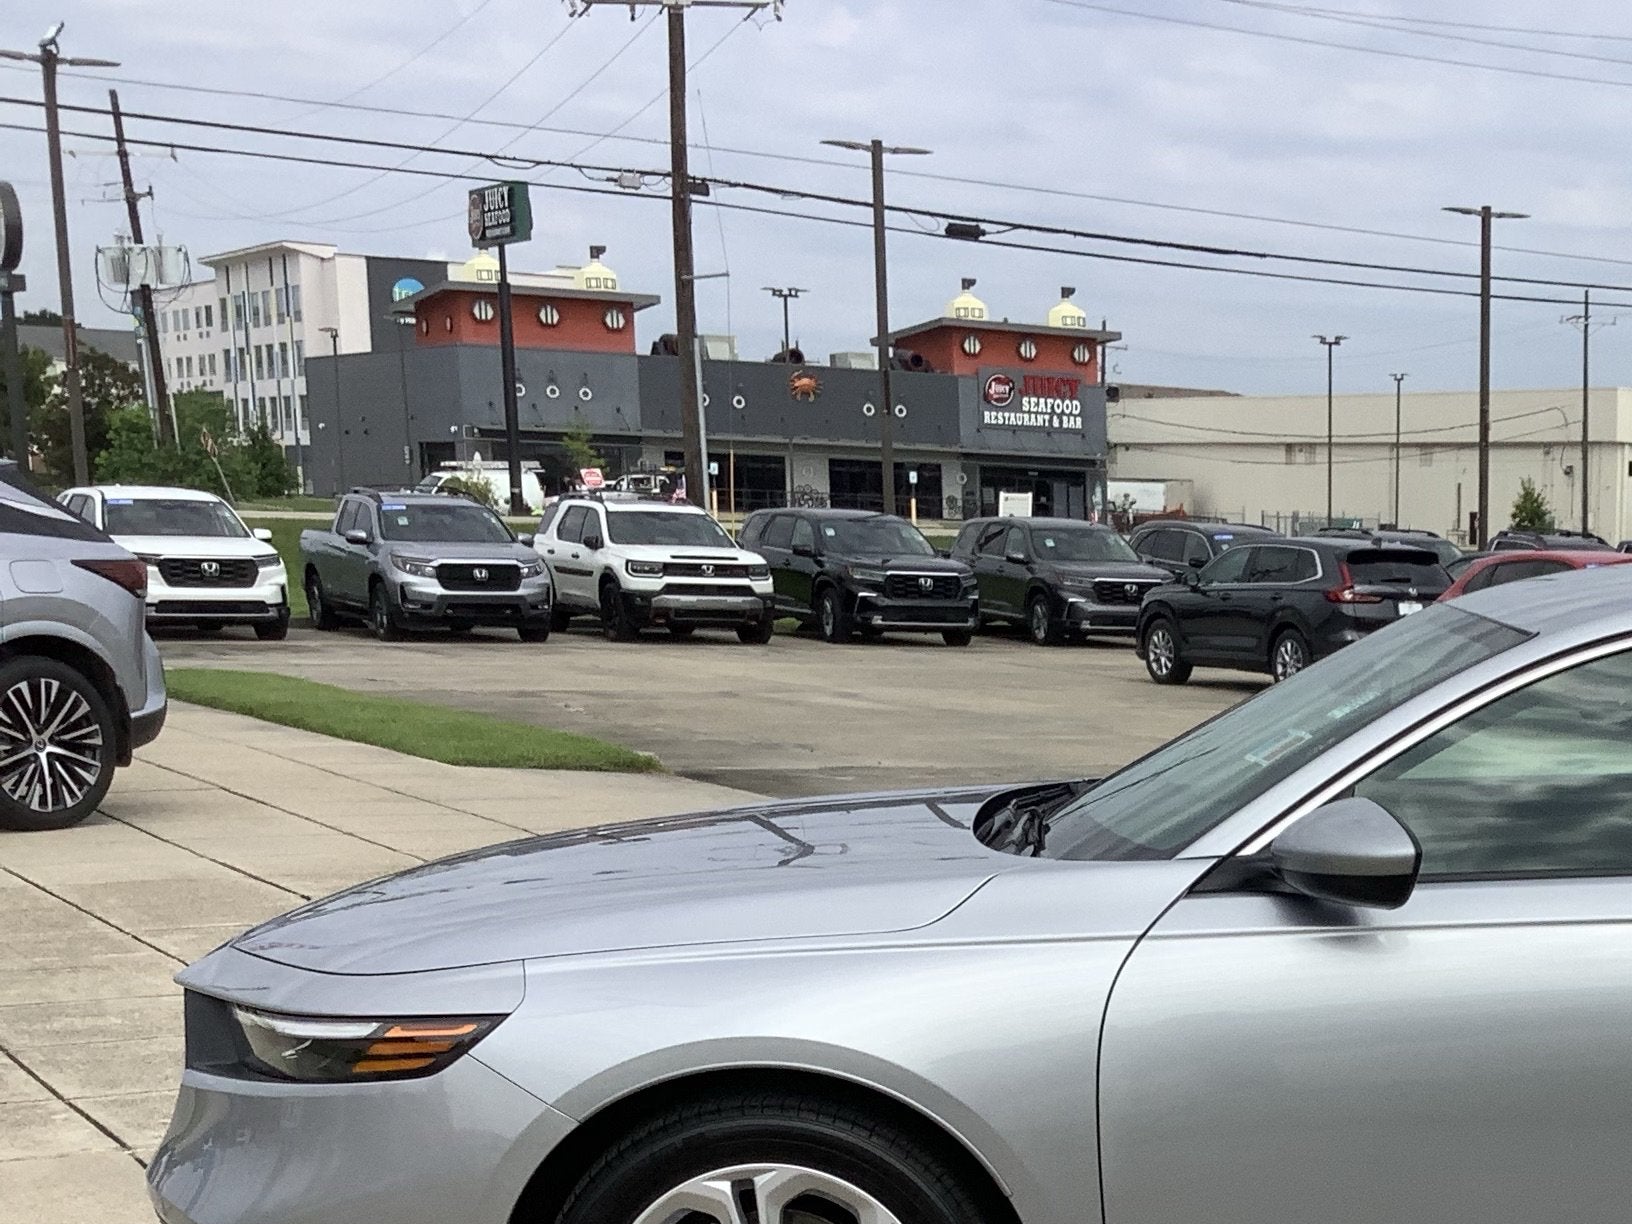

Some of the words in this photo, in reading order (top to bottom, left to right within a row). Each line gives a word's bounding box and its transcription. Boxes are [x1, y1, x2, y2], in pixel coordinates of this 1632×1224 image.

[483, 186, 509, 211] JUICY
[1022, 397, 1081, 415] SEAFOOD
[983, 411, 1050, 427] RESTAURANT
[1052, 415, 1060, 428] &
[1062, 415, 1082, 429] BAR
